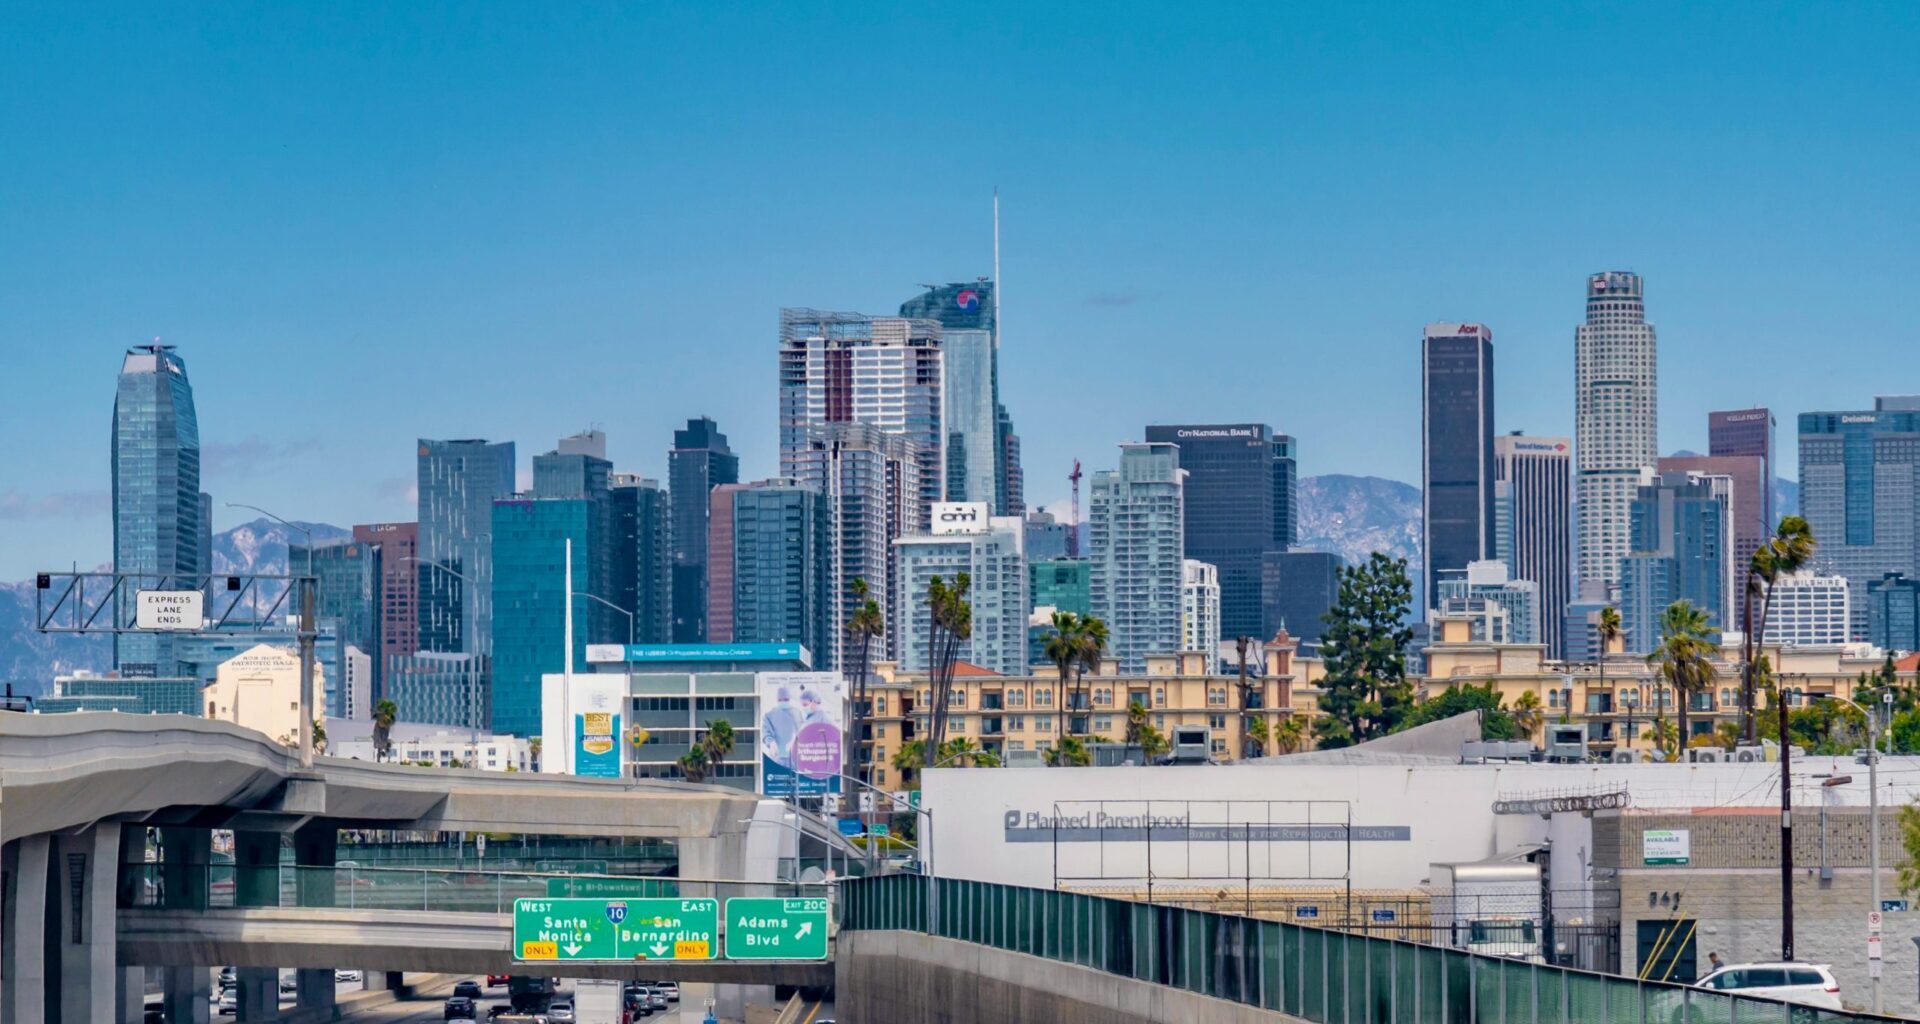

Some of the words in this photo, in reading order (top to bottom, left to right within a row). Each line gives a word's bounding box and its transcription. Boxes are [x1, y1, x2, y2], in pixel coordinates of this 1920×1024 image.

[1230, 428, 1252, 437] BANK
[1793, 579, 1840, 587] WILSHIRE
[586, 712, 609, 722] BEST
[1026, 811, 1090, 829] Planned
[1096, 811, 1189, 829] Parenthood
[1281, 830, 1349, 840] REPRODUCTIV
[1358, 830, 1395, 839] HEALTH
[564, 882, 583, 890] Pco
[520, 901, 552, 912] WEST
[681, 901, 712, 912] EAST
[803, 901, 826, 910] 20C
[610, 907, 624, 919] 10
[544, 916, 587, 928] Santa
[653, 916, 681, 928] San
[738, 916, 788, 928] Adams
[539, 930, 591, 941] Monica
[622, 930, 709, 942] Bernardino
[746, 934, 779, 945] Blvd
[525, 946, 554, 955] ONLY
[677, 945, 706, 954] ONLY
